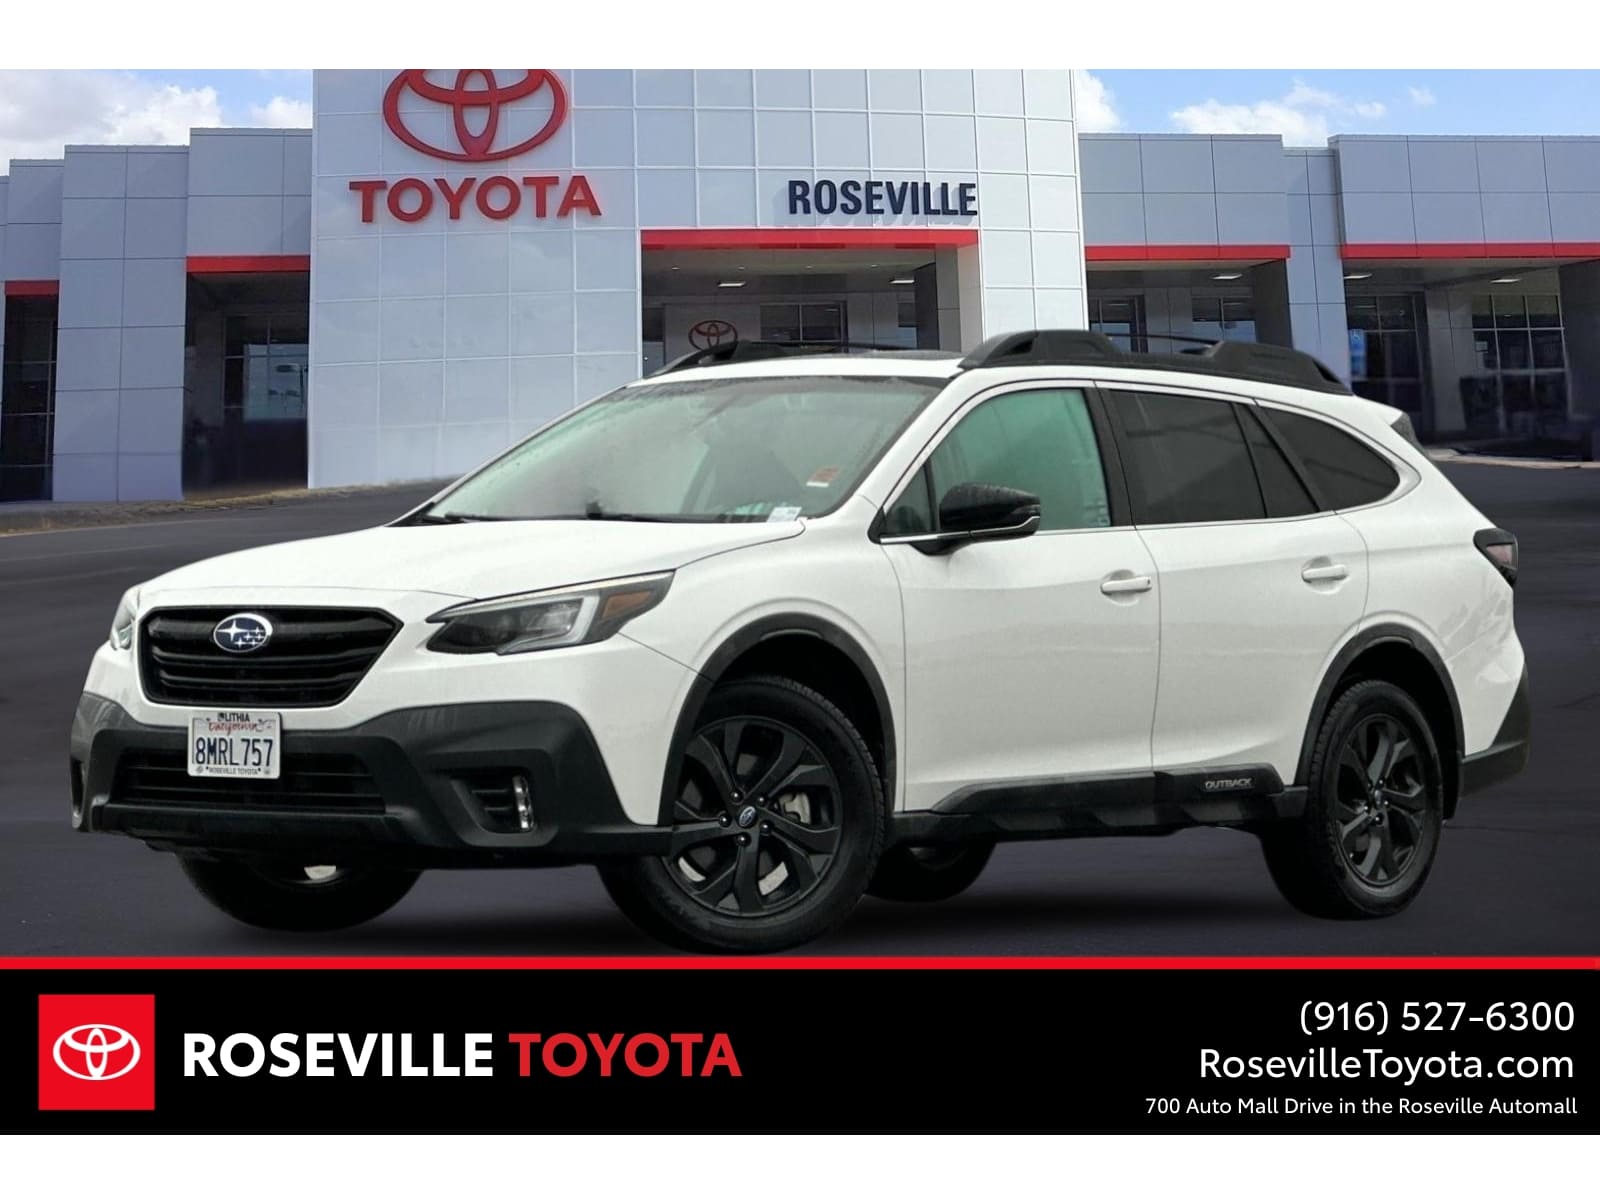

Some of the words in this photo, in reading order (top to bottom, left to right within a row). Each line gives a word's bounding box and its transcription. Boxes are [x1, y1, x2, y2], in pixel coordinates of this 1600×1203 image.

[349, 175, 602, 223] TOYOTA
[788, 180, 978, 217] ROSEVILLE
[195, 736, 273, 767] 8MRL757
[1204, 778, 1251, 789] OUTBACK
